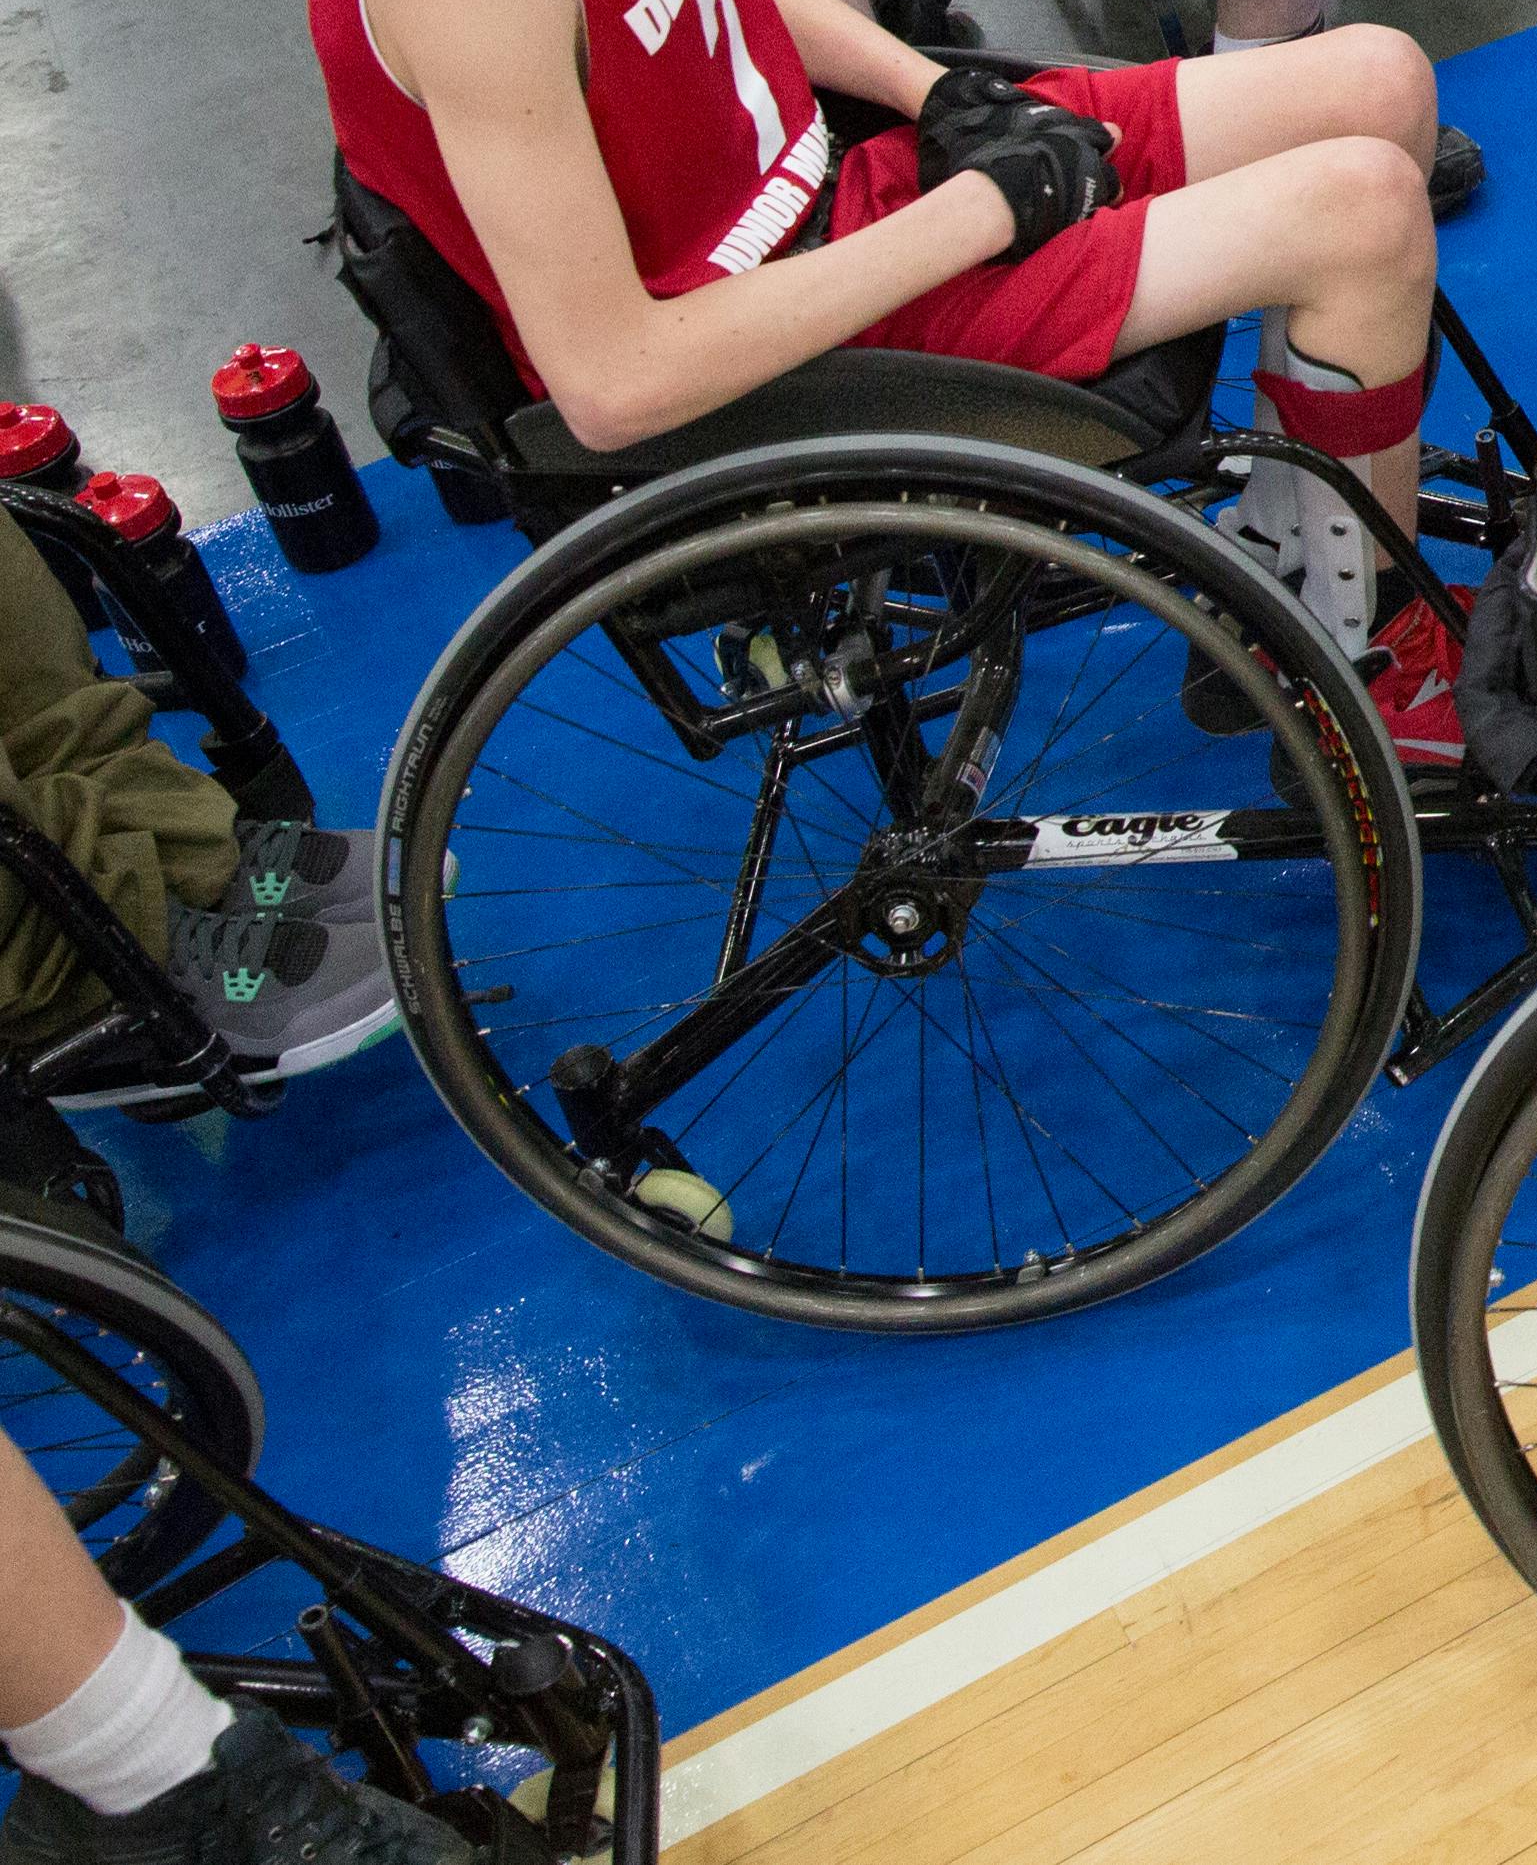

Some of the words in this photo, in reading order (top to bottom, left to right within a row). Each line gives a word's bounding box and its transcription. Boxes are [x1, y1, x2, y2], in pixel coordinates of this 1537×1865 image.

[707, 176, 812, 276] JUNIOR
[391, 722, 434, 832] RIGHTRUN
[387, 903, 421, 1017] SCHWALBE
